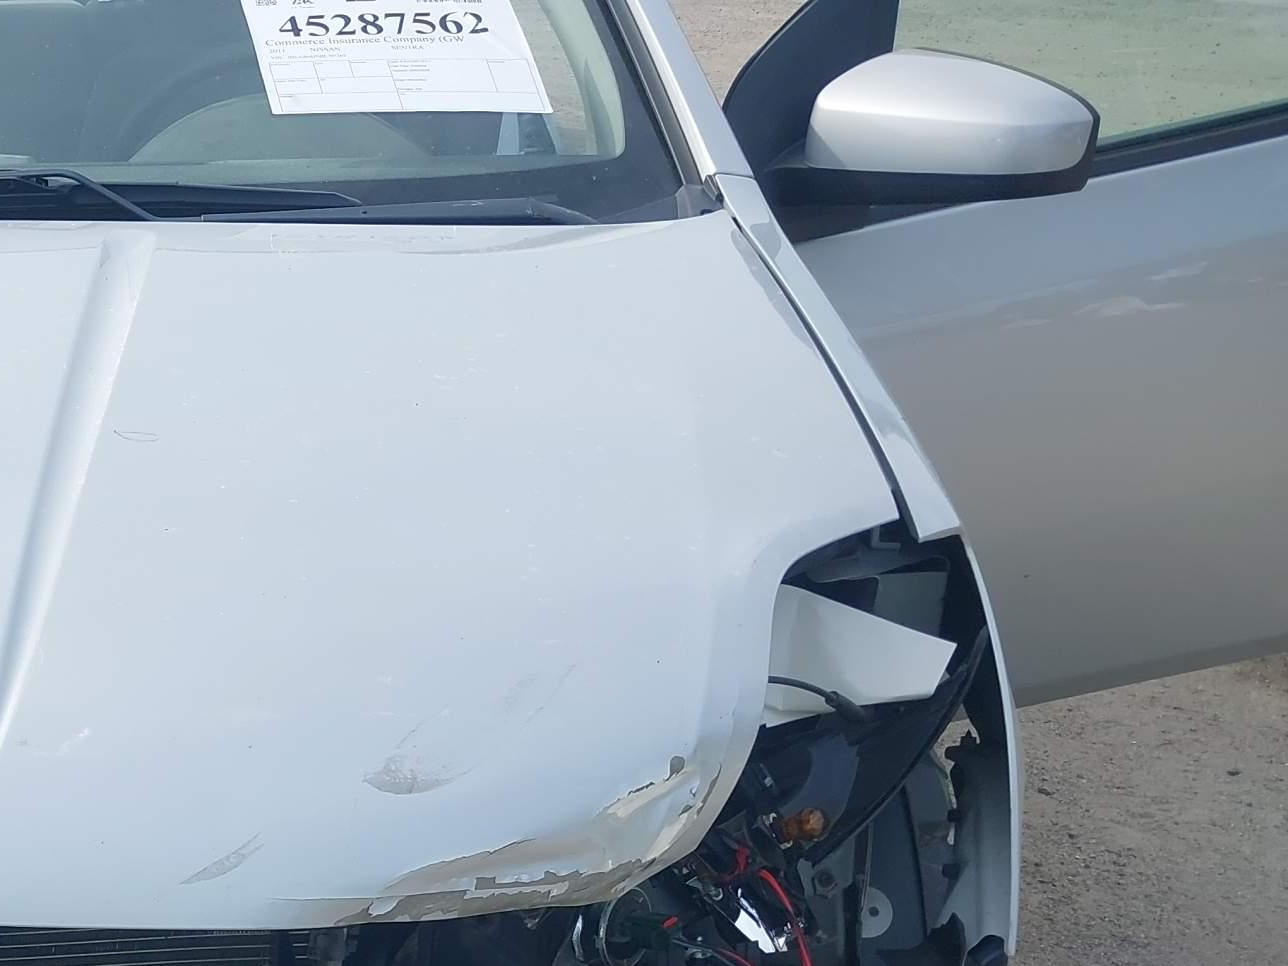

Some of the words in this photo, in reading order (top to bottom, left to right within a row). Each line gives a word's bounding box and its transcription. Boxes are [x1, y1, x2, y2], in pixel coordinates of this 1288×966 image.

[279, 11, 489, 37] 45287562
[265, 38, 325, 47] Commerce
[328, 36, 381, 45] Insurance
[383, 34, 435, 44] Company
[438, 34, 464, 43] (GW
